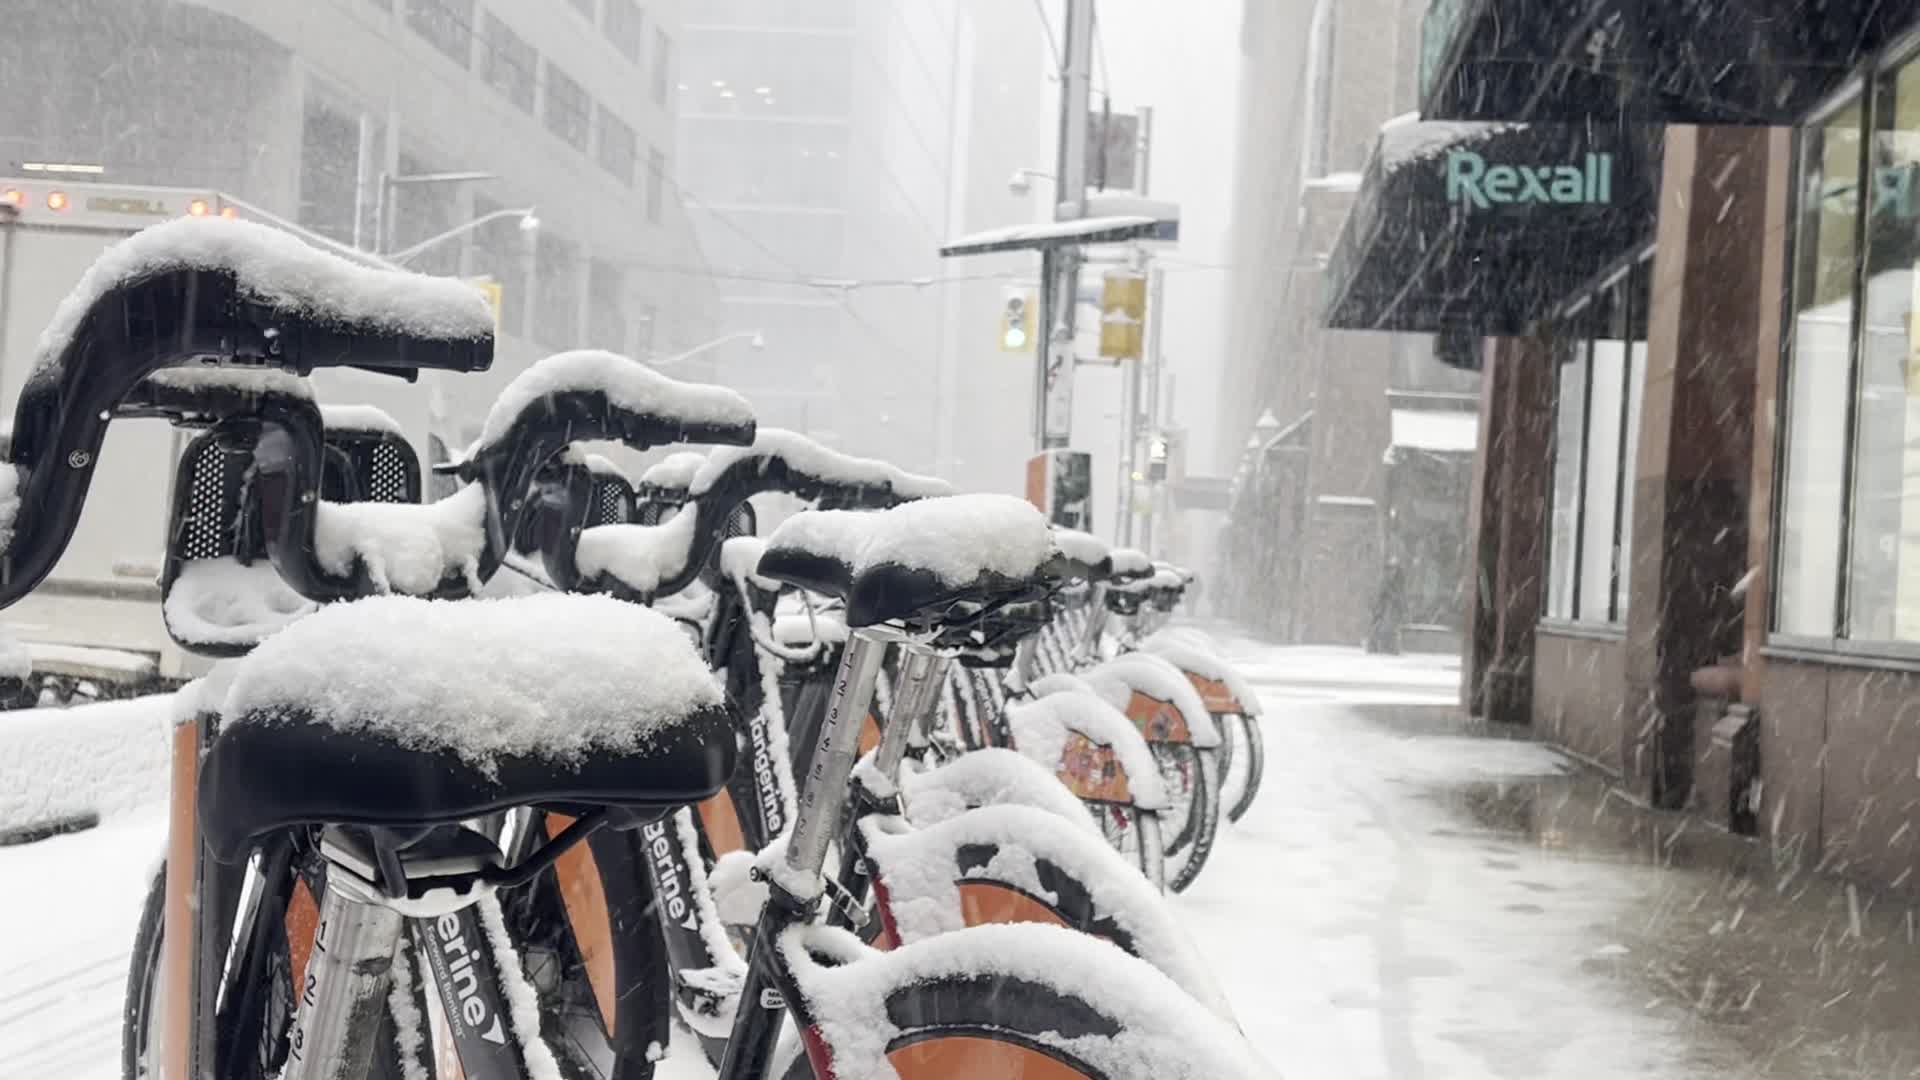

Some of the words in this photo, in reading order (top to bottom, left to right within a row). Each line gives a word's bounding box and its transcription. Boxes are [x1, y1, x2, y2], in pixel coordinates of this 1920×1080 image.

[1448, 150, 1611, 208] Rexall
[749, 715, 781, 832] Tangerine
[320, 920, 327, 941] 1
[427, 924, 449, 980] Forward
[306, 974, 317, 998] 2
